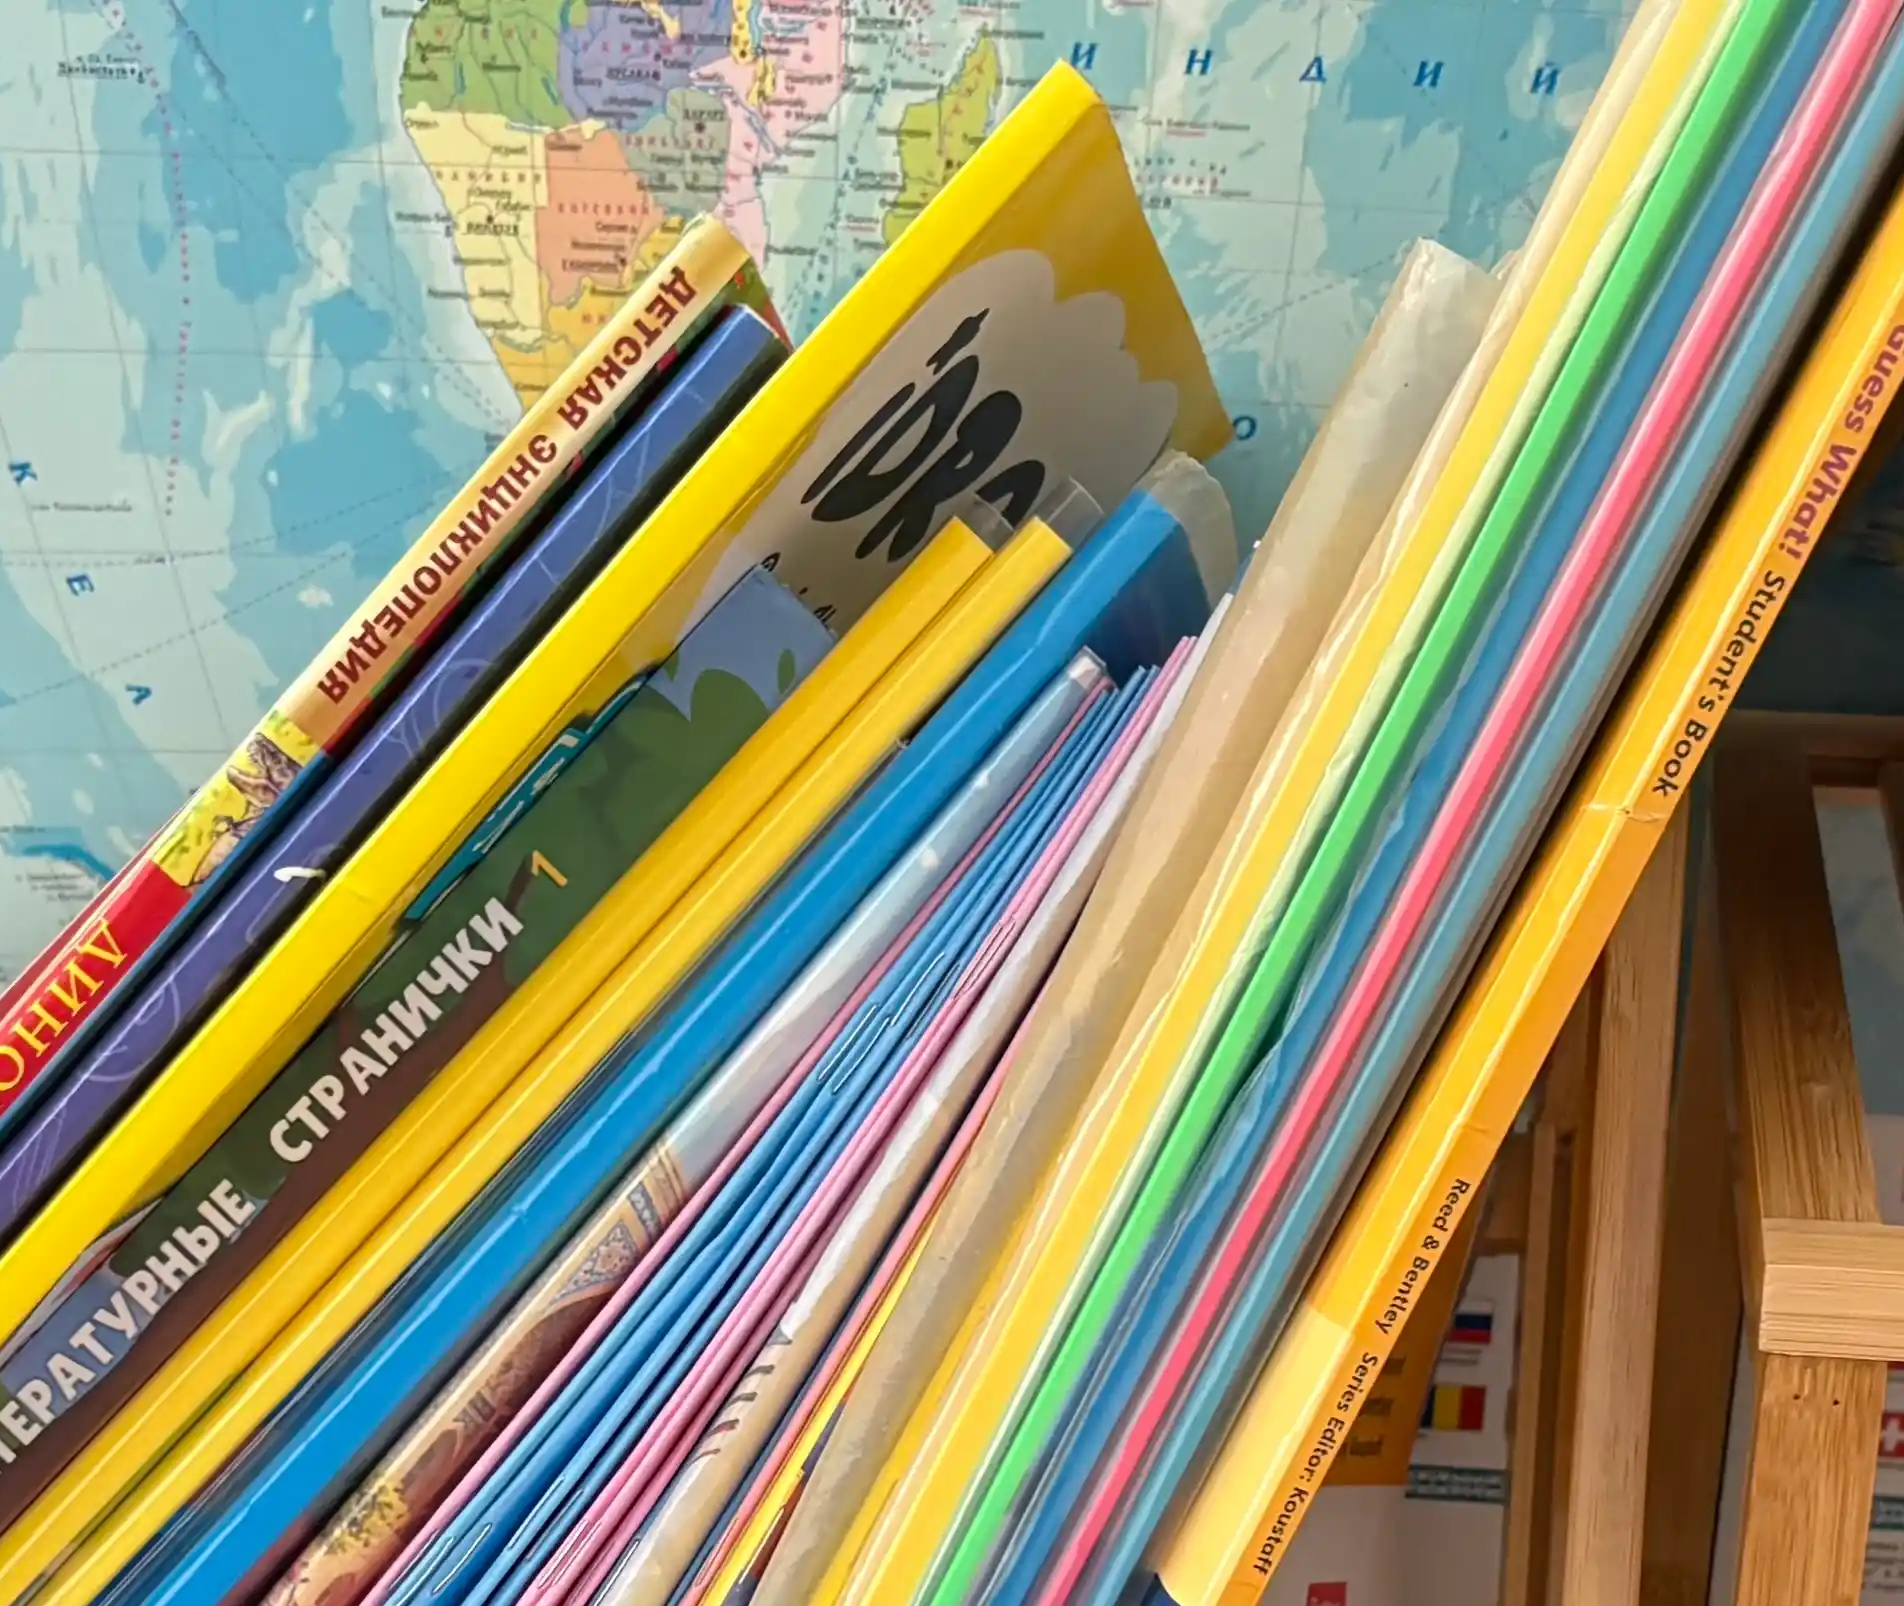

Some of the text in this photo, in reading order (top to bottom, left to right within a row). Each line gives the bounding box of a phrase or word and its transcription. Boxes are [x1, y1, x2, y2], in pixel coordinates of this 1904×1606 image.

[316, 266, 697, 706] ДЕТСКАЯ ЭНЦИКЛОПЕДИЯ
[1778, 444, 1857, 560] What!
[1698, 570, 1785, 712] Student's
[1652, 717, 1708, 797] Book
[269, 897, 525, 1163] СТРАНИЧКИ
[531, 849, 569, 887] 1
[1375, 1178, 1471, 1336] Reed & Bentley
[1254, 1352, 1379, 1576] Series Editor: Koustaff
